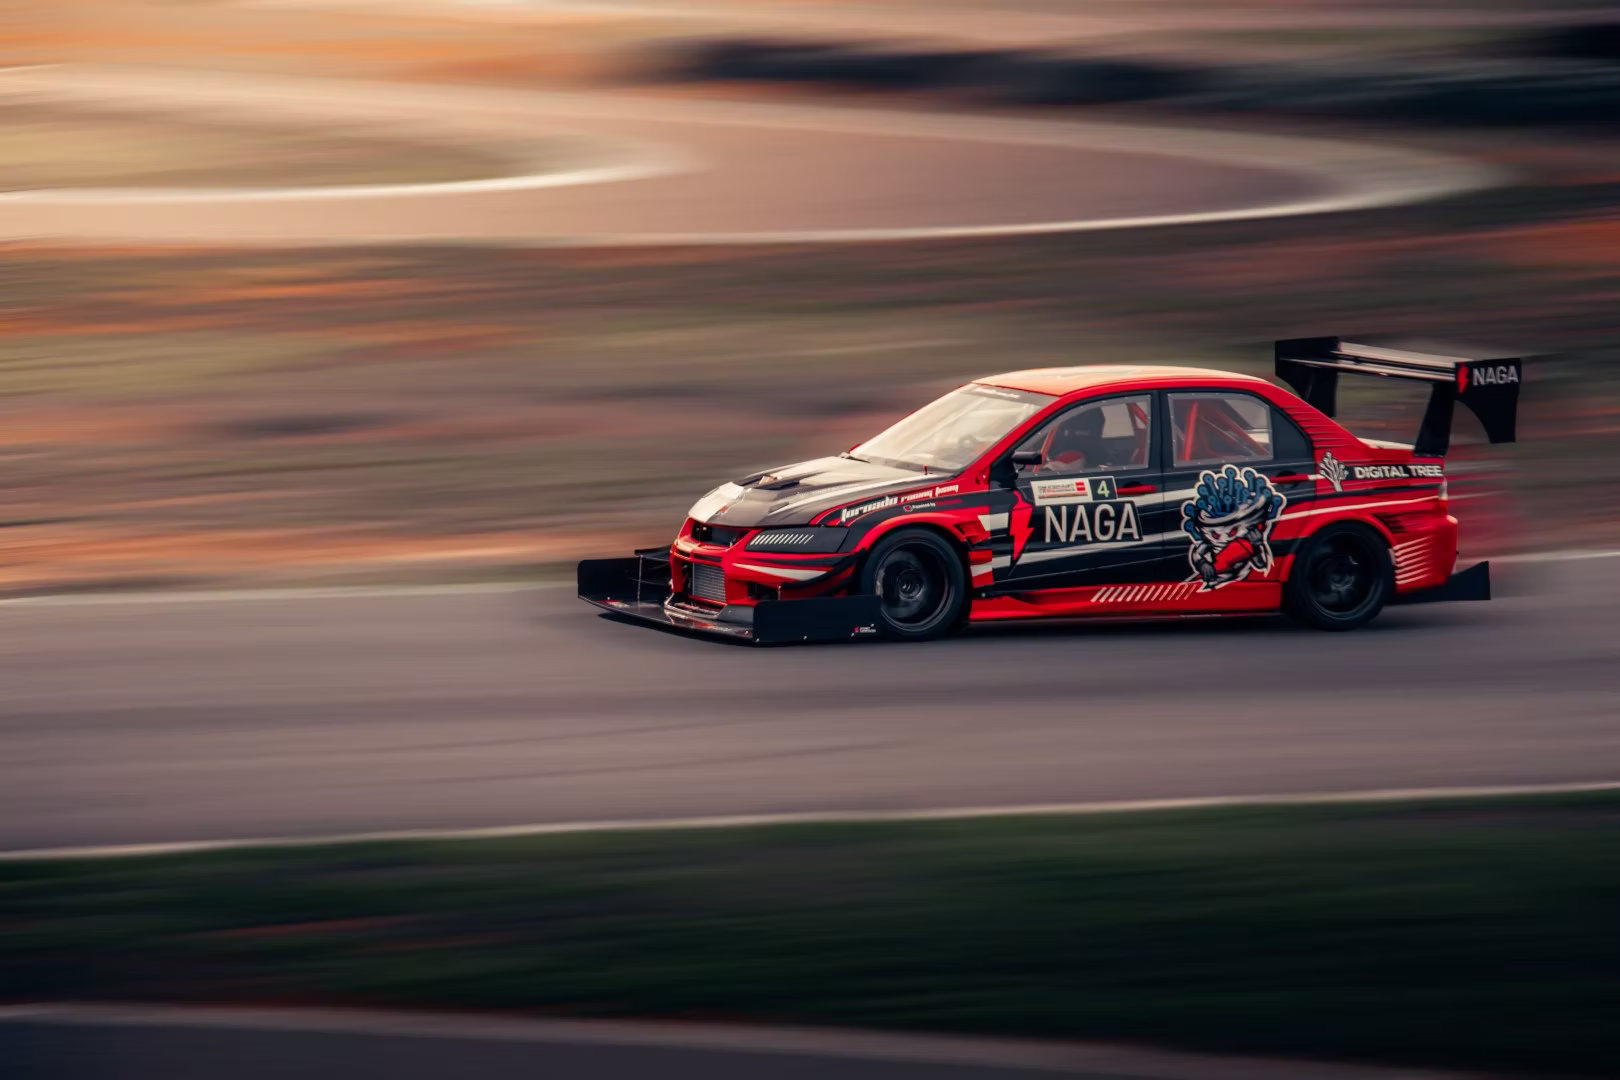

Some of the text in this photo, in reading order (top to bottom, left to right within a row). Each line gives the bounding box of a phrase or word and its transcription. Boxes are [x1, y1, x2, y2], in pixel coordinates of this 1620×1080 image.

[1472, 365, 1519, 386] NAGA
[1354, 465, 1443, 479] DIGITAL TREE
[1097, 480, 1110, 498] 4
[1045, 503, 1139, 543] NAGA
